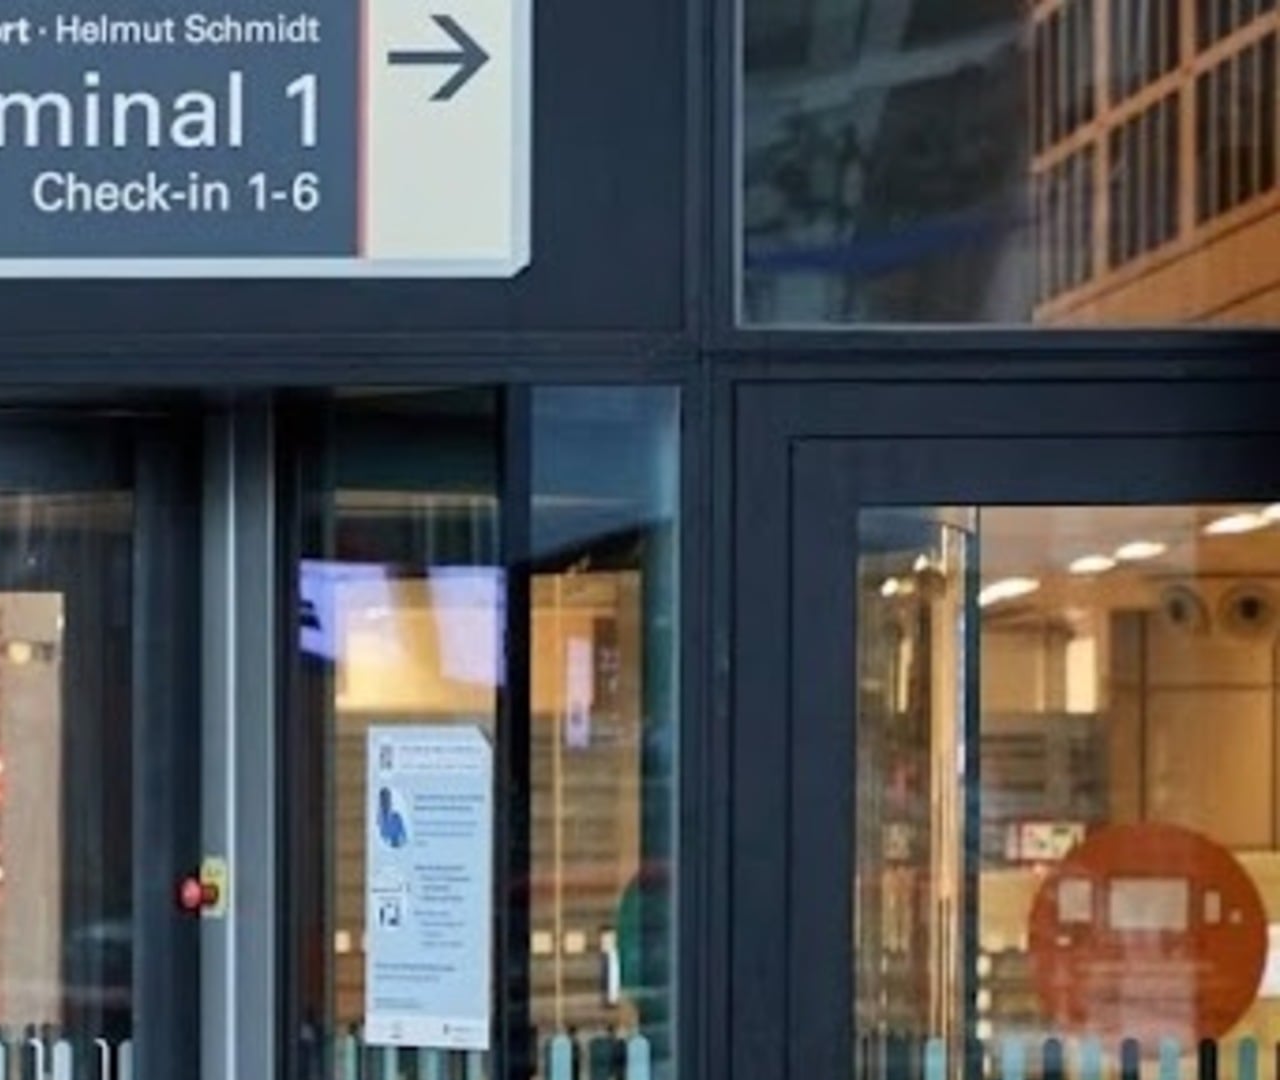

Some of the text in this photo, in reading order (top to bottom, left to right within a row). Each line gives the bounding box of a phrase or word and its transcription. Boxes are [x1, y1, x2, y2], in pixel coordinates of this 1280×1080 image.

[55, 13, 176, 45] Helmut
[183, 12, 321, 45] Schmidt
[284, 73, 317, 148] 1
[31, 170, 320, 213] Check-in 1-6
